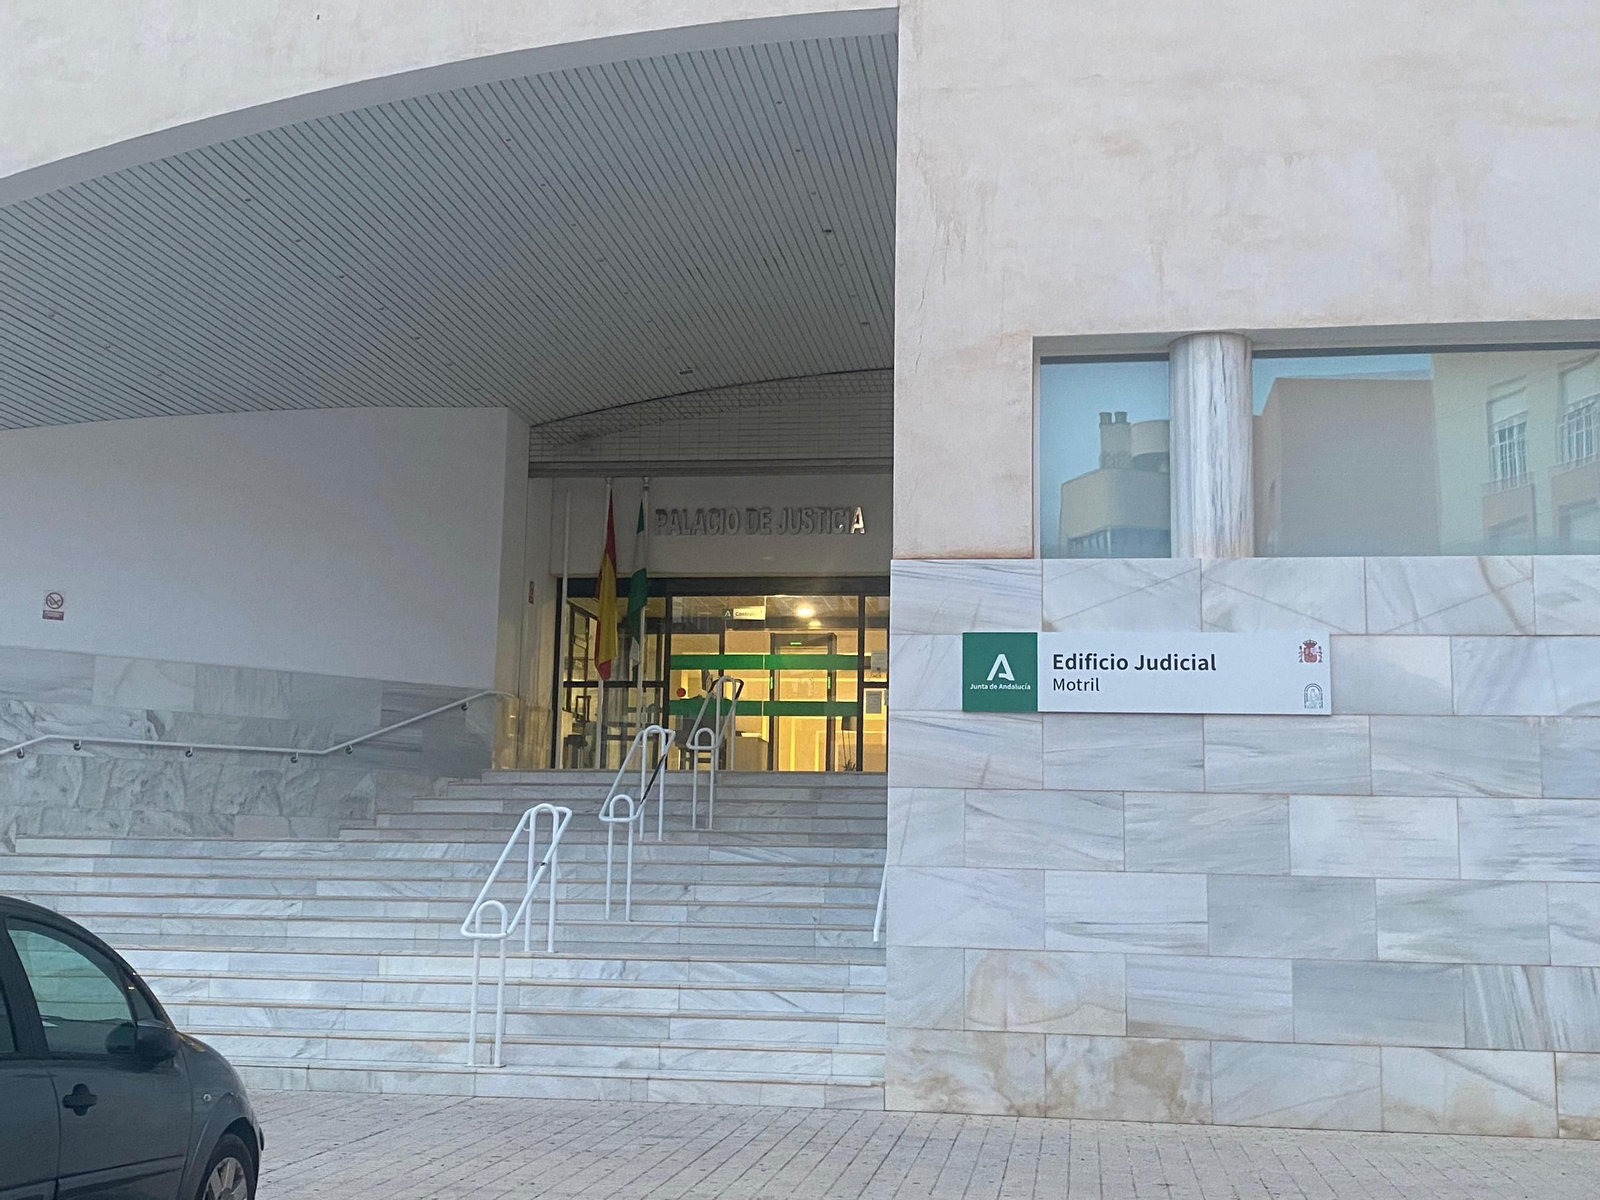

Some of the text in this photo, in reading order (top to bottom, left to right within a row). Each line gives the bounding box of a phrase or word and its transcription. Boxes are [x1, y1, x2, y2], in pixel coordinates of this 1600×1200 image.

[655, 506, 866, 536] PALACIO DE JUSTICIA
[1053, 653, 1217, 671] Edificio Judicial
[998, 682, 1031, 690] Andalucía
[1053, 677, 1100, 691] Motril
